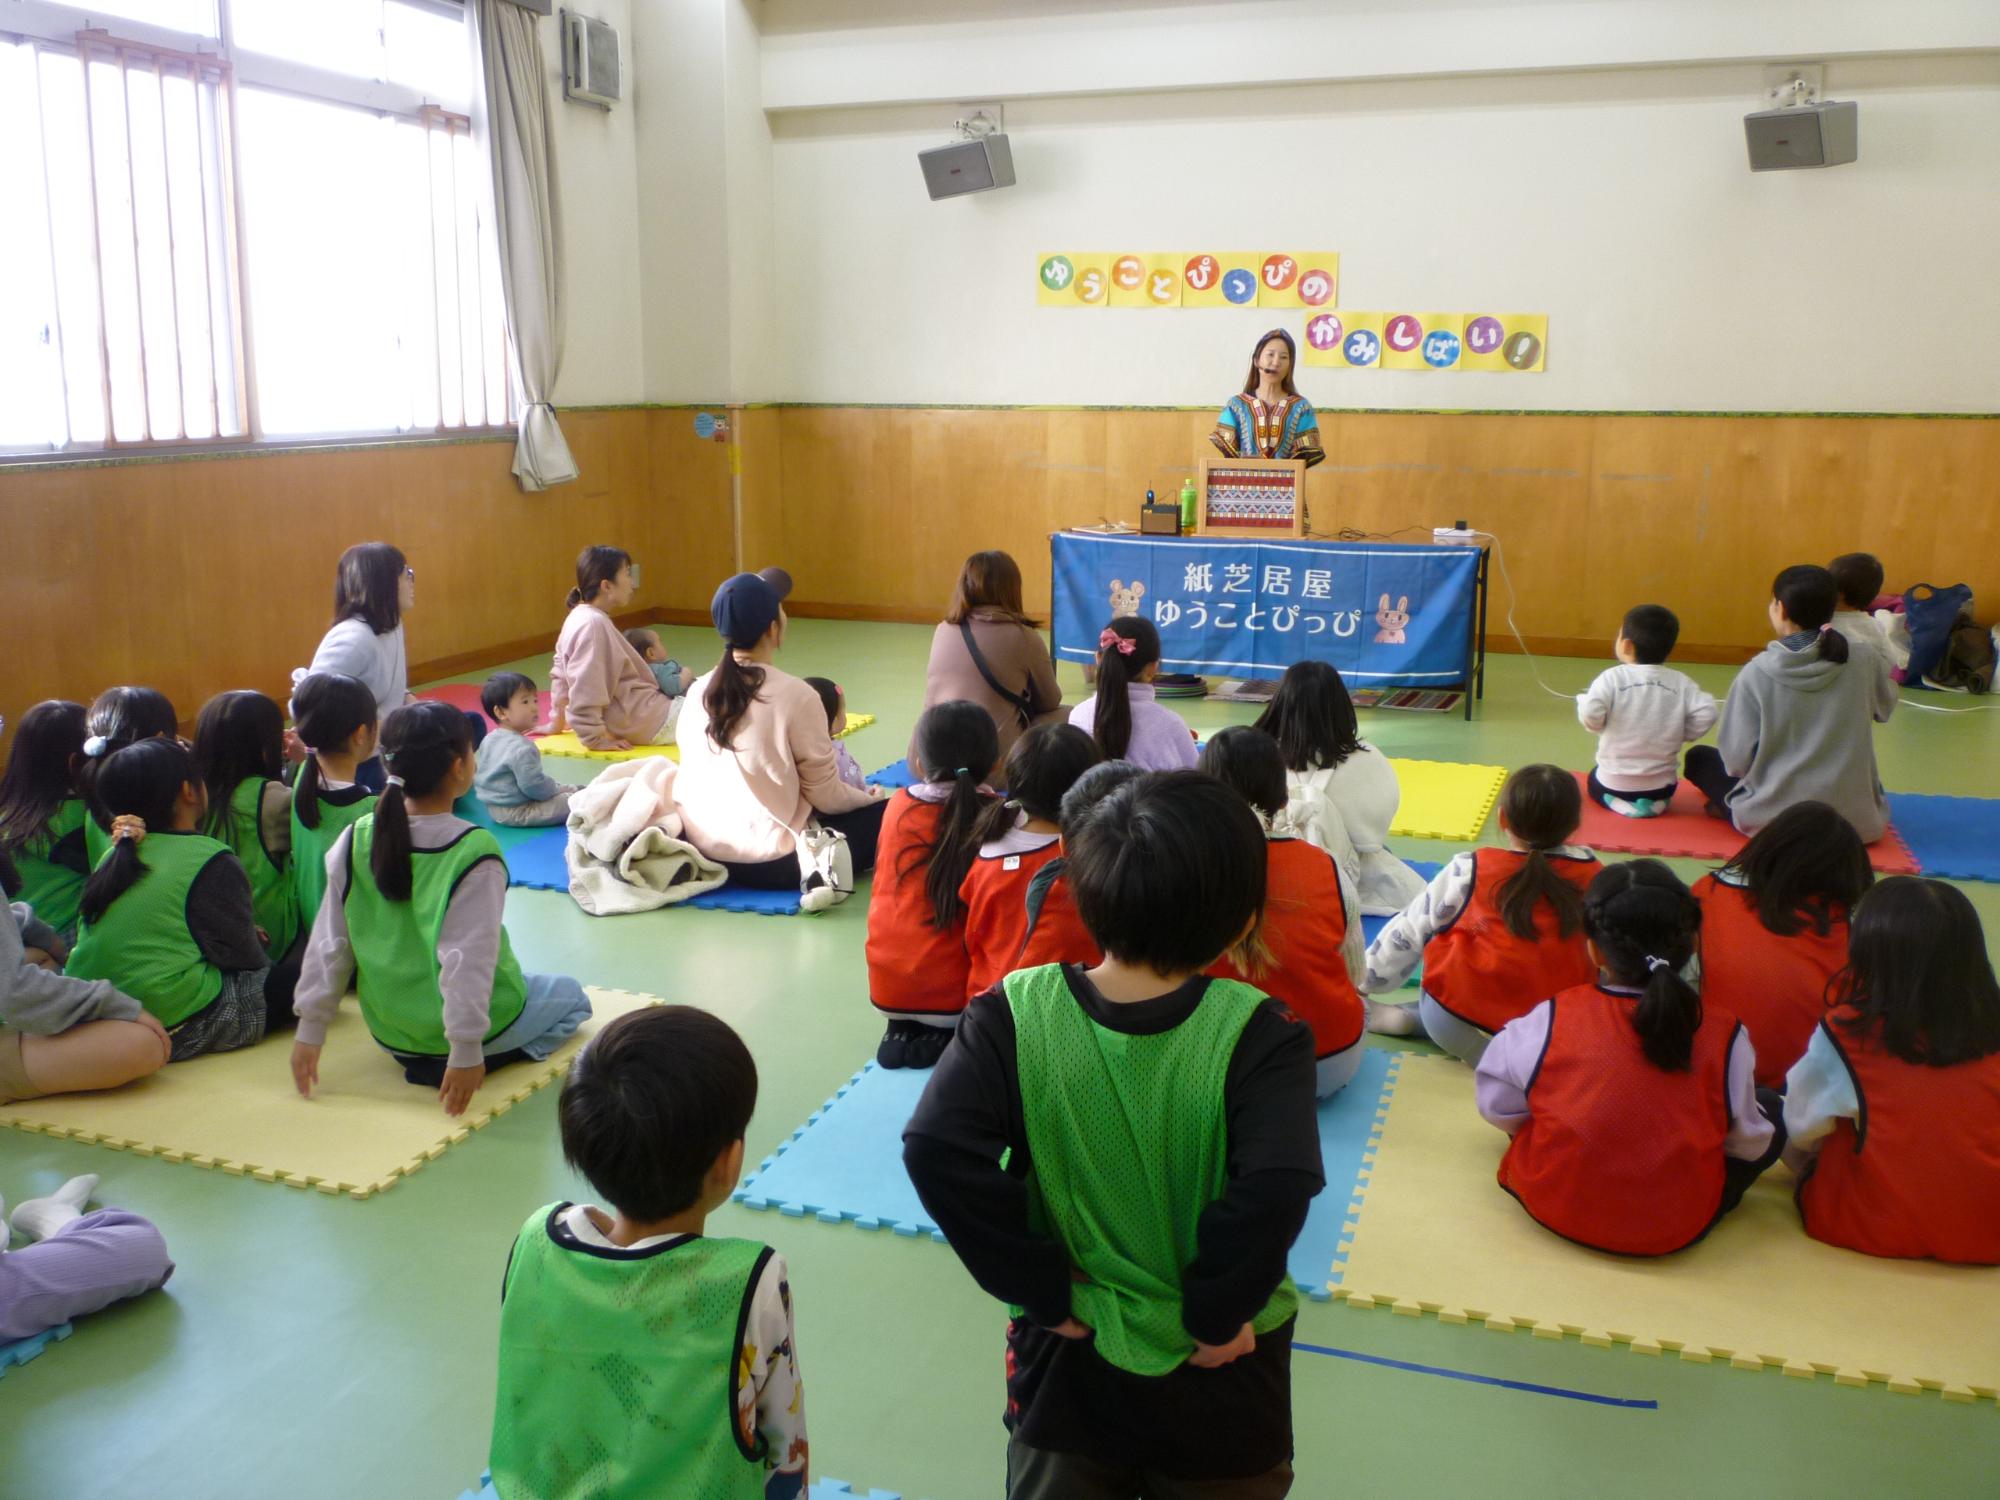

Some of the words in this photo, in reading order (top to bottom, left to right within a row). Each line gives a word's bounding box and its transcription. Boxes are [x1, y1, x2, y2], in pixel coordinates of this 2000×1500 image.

[1045, 256, 1329, 301] ゆうことぴっぴの
[1183, 562, 1332, 599] 紙芝居屋
[1154, 600, 1361, 637] ゆうことぴっぴ
